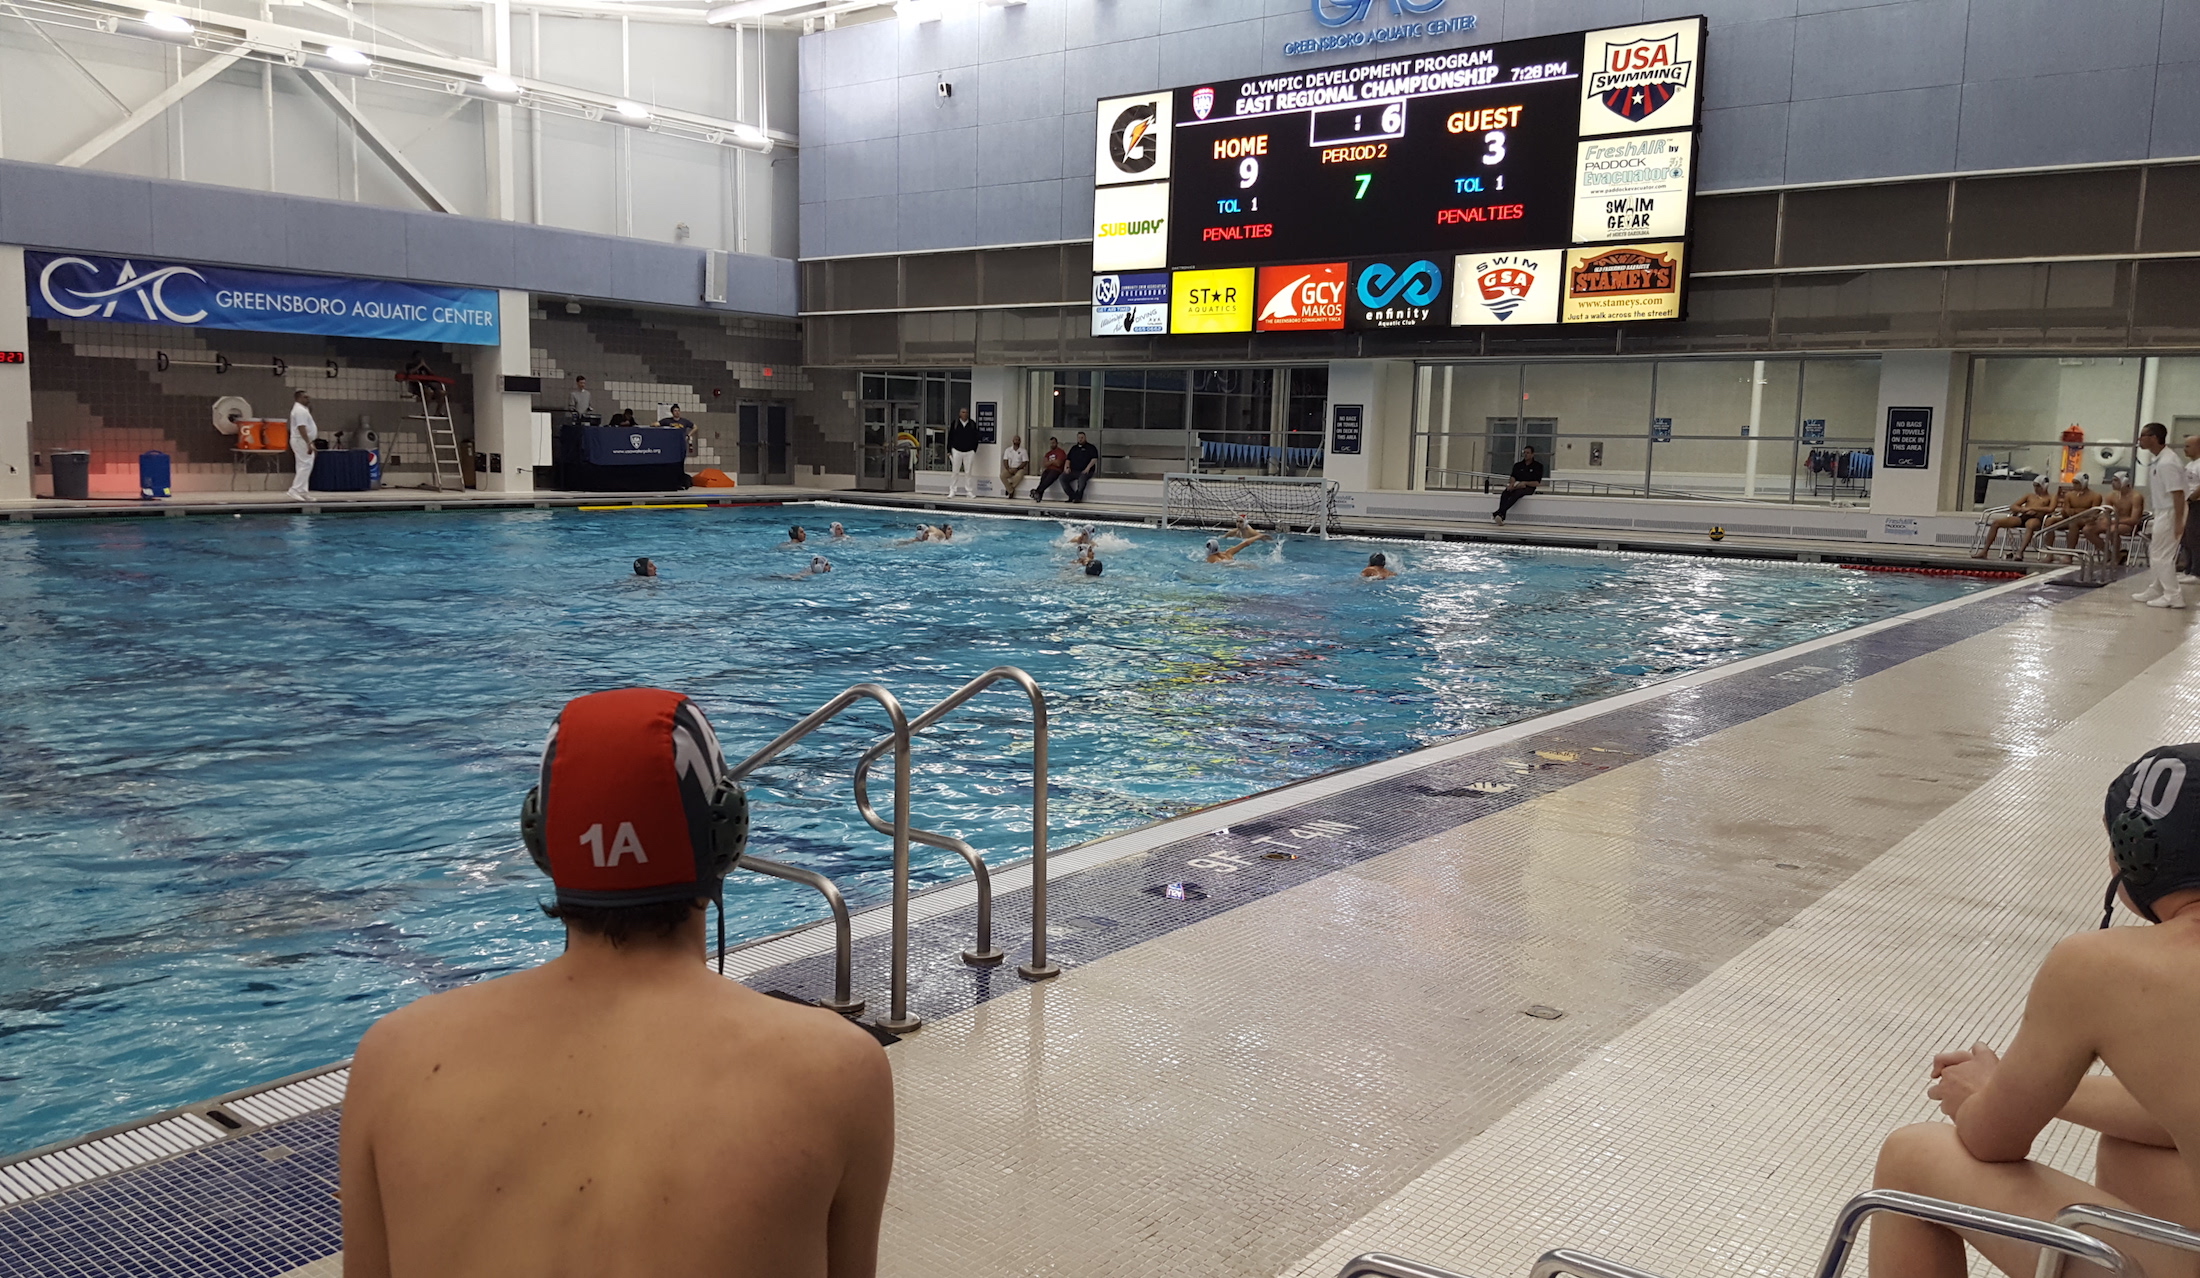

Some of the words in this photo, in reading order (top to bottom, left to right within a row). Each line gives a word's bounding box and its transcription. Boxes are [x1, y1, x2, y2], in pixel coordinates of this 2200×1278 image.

[1284, 32, 1365, 56] GREENSBORO
[1368, 24, 1422, 45] AQUATIC
[1426, 15, 1477, 36] CENTER
[1612, 44, 1668, 72] USA
[1241, 76, 1302, 96] OLYMPIC
[1306, 61, 1411, 87] DEVELOPMENT
[1414, 50, 1494, 73] PROGRAM
[1510, 65, 1542, 82] 7:28
[1545, 62, 1568, 77] PM
[1596, 67, 1682, 88] SWIMMING
[1236, 97, 1273, 116] EAST
[1276, 84, 1358, 110] REGIONAL
[1361, 66, 1499, 99] CHAMPIONSHIP
[1381, 104, 1401, 133] 6
[1447, 105, 1523, 134] GUEST
[1213, 134, 1269, 159] HOME
[1322, 145, 1376, 164] PERIOD
[1377, 143, 1388, 158] 2
[1482, 131, 1506, 165] 3
[1585, 139, 1667, 160] FreshAIR
[1668, 145, 1680, 153] by
[1239, 157, 1259, 189] 9
[1584, 158, 1647, 171] PADDOCK
[1354, 173, 1372, 199] 7
[1455, 177, 1484, 193] TOL
[1495, 175, 1504, 191] 1
[1217, 199, 1241, 213] TOL
[1250, 197, 1258, 211] 1
[1437, 204, 1524, 224] PENALTIES
[1606, 198, 1654, 213] SWIM
[1098, 218, 1164, 237] SUBWAY
[1607, 213, 1650, 228] GEAR
[1203, 223, 1274, 241] PENALTIES
[1476, 256, 1538, 272] SWIM
[1483, 270, 1527, 287] GSA
[1576, 268, 1669, 291] STAMEY'S
[1097, 280, 1117, 303] CSA
[1301, 281, 1345, 304] GCY
[215, 290, 347, 316] GREENSBORO
[351, 299, 428, 323] AQUATIC
[432, 306, 493, 327] CENTER
[1188, 305, 1237, 313] AQUATICS
[1301, 304, 1342, 317] MAKOS
[1578, 297, 1663, 308] www.stameys.com
[1365, 307, 1429, 321] enfinity
[2126, 754, 2187, 820] 10
[580, 821, 648, 868] 1A
